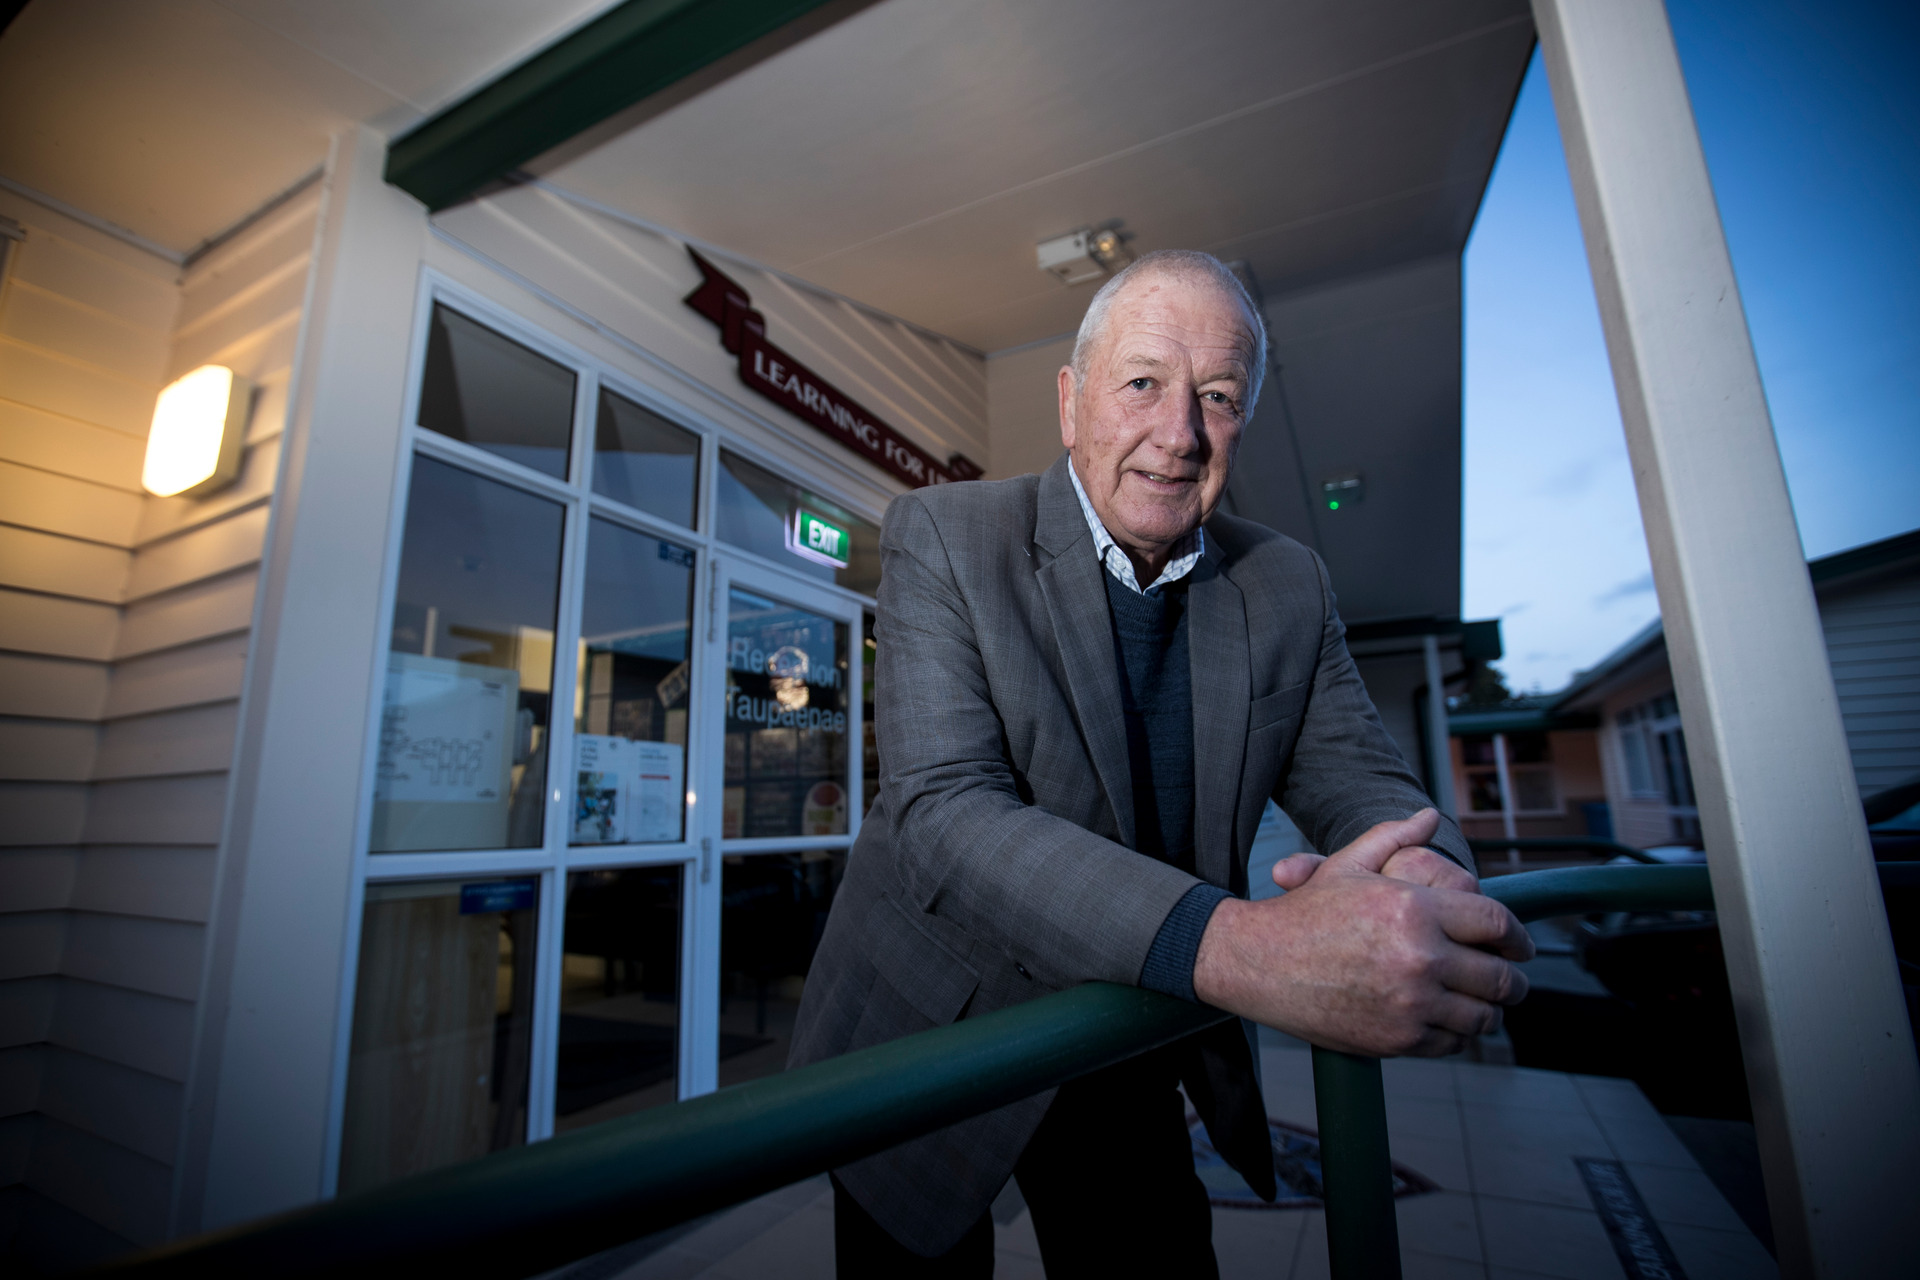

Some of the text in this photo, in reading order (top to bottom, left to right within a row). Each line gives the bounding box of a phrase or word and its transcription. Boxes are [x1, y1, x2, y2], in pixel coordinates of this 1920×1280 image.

[754, 349, 880, 450] LEARNING
[884, 438, 925, 481] FOR
[808, 519, 841, 556] EXIT
[727, 685, 846, 735] Taupaepae
